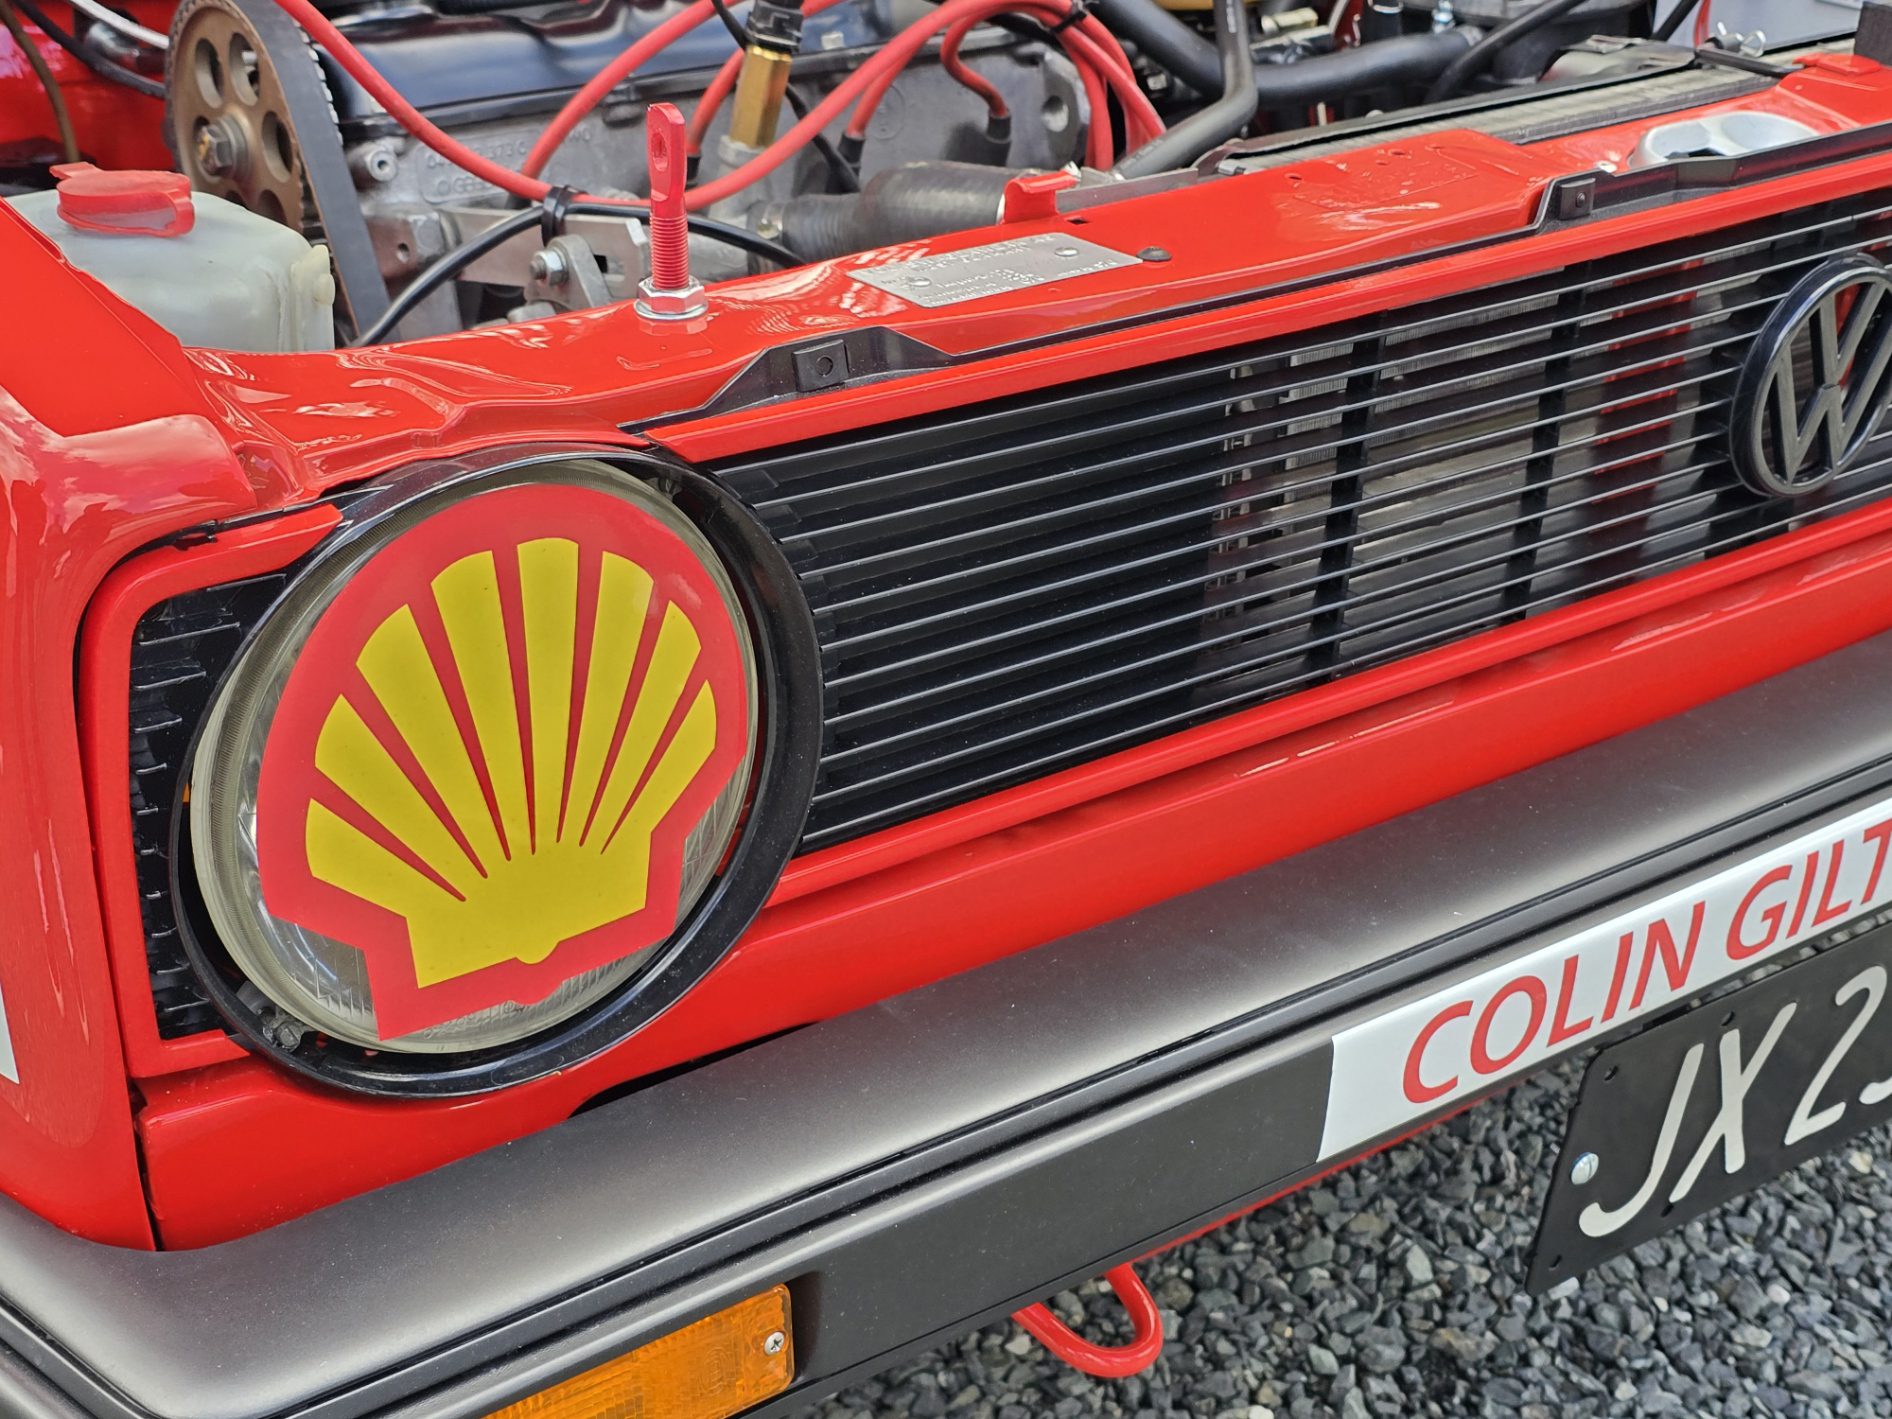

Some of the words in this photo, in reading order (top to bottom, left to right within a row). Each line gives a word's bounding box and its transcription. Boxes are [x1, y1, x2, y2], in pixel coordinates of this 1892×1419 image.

[1402, 902, 1705, 1104] COLIN
[1725, 819, 1892, 961] GILT
[1578, 1001, 1799, 1238] JX
[1784, 965, 1892, 1146] 2
